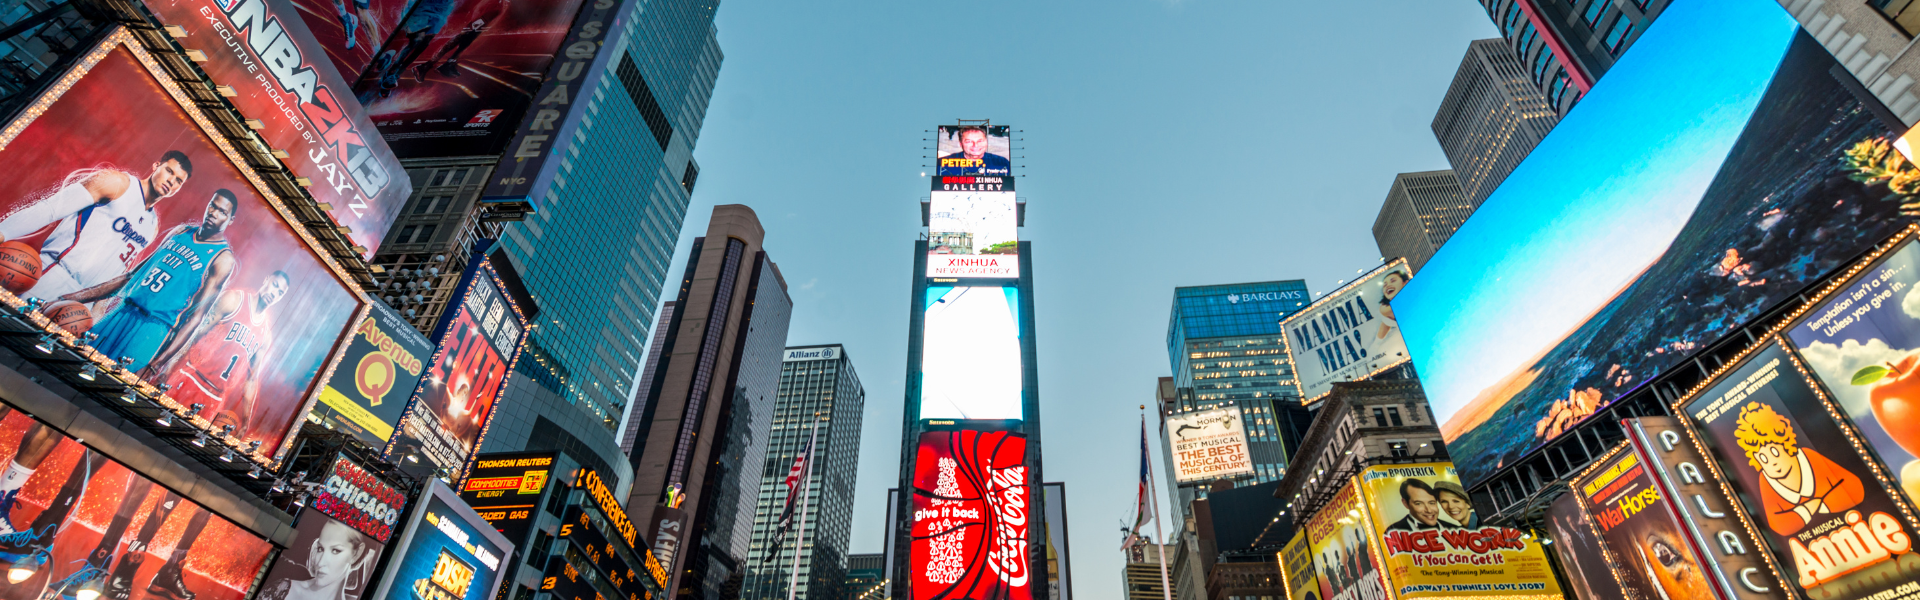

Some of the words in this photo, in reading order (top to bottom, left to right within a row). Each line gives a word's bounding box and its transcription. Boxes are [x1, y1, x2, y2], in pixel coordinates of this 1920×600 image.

[514, 21, 602, 158] SQUARE
[200, 6, 258, 73] EXECUTIVE
[256, 74, 304, 131] PRODUCED
[302, 131, 316, 144] BY
[309, 147, 353, 196] JAY
[348, 194, 368, 219] Z
[941, 158, 973, 168] PETER
[975, 158, 986, 168] P.
[500, 177, 526, 185] NYC
[944, 183, 1003, 191] GALLERY
[975, 176, 1003, 184] XINHUA
[0, 253, 37, 275] PALDING
[162, 253, 183, 270] CITY
[948, 258, 998, 267] XINHUA
[141, 267, 172, 293] 35
[1242, 290, 1301, 302] BARCLAYS
[1807, 298, 1853, 332] Temptation
[1850, 283, 1872, 301] isn't
[1871, 279, 1881, 288] a
[1880, 264, 1906, 282] sin...
[1823, 315, 1854, 337] Unless
[1852, 303, 1871, 322] you
[1870, 289, 1892, 309] give
[1889, 281, 1906, 293] in.
[382, 317, 395, 330] BEST
[395, 328, 416, 347] MUSICAL
[1293, 295, 1374, 355] MAMMA
[357, 316, 422, 376] Avenue
[789, 351, 820, 359] Allianz
[1316, 329, 1367, 377] MIA!
[220, 354, 238, 381] 1
[355, 351, 396, 407] Q
[433, 307, 506, 428] EVITA
[1695, 408, 1708, 421] THE
[1706, 397, 1724, 412] TONY
[1724, 358, 1780, 401] AWARD-WINNING
[1704, 409, 1720, 424] BEST
[1719, 391, 1747, 414] MUSICAL
[1745, 369, 1779, 395] RETURNS!
[1177, 443, 1198, 451] BEST
[1201, 437, 1241, 447] MUSICAL
[1207, 444, 1242, 457] BEST
[478, 459, 516, 468] THOMSON
[516, 457, 552, 466] REUTERS
[1180, 456, 1227, 469] MUSICAL
[1229, 453, 1245, 462] OF
[1181, 467, 1201, 476] THIS
[1388, 466, 1436, 478] BRODERICK
[336, 457, 404, 510] CHICAGO
[470, 479, 518, 489] COMMODITIES
[476, 490, 505, 498] ENERGY
[326, 475, 397, 526] CHICAGO
[586, 470, 627, 533] CONFERENCE
[623, 520, 637, 548] CALL
[1309, 513, 1324, 533] THE
[1324, 483, 1355, 517] CROWD
[1657, 430, 1770, 593] PALAC
[316, 492, 390, 542] CHICAGO
[509, 510, 529, 519] GAS
[915, 508, 938, 521] give
[941, 507, 950, 518] it
[953, 507, 979, 519] back
[987, 459, 1029, 588] Coca-Cola
[560, 524, 574, 536] 5
[1312, 519, 1335, 545] GOES
[1383, 529, 1446, 557] NICE
[1441, 526, 1525, 555] WORK
[1798, 530, 1813, 542] THE
[1812, 517, 1844, 537] MUSICAL
[1412, 555, 1423, 567] If
[1424, 555, 1447, 567] You
[1447, 553, 1469, 565] Can
[1470, 554, 1492, 566] Get
[1492, 552, 1504, 565] It
[1789, 510, 1912, 589] Annie
[431, 552, 473, 599] DISH
[541, 576, 557, 590] 3
[1434, 569, 1478, 577] Tony-Winning
[1479, 568, 1504, 576] Musical
[1400, 583, 1451, 596] BROADWAY'S
[1451, 583, 1492, 593] FUNNIEST
[1493, 582, 1517, 591] LOVE
[1518, 582, 1545, 591] STORY
